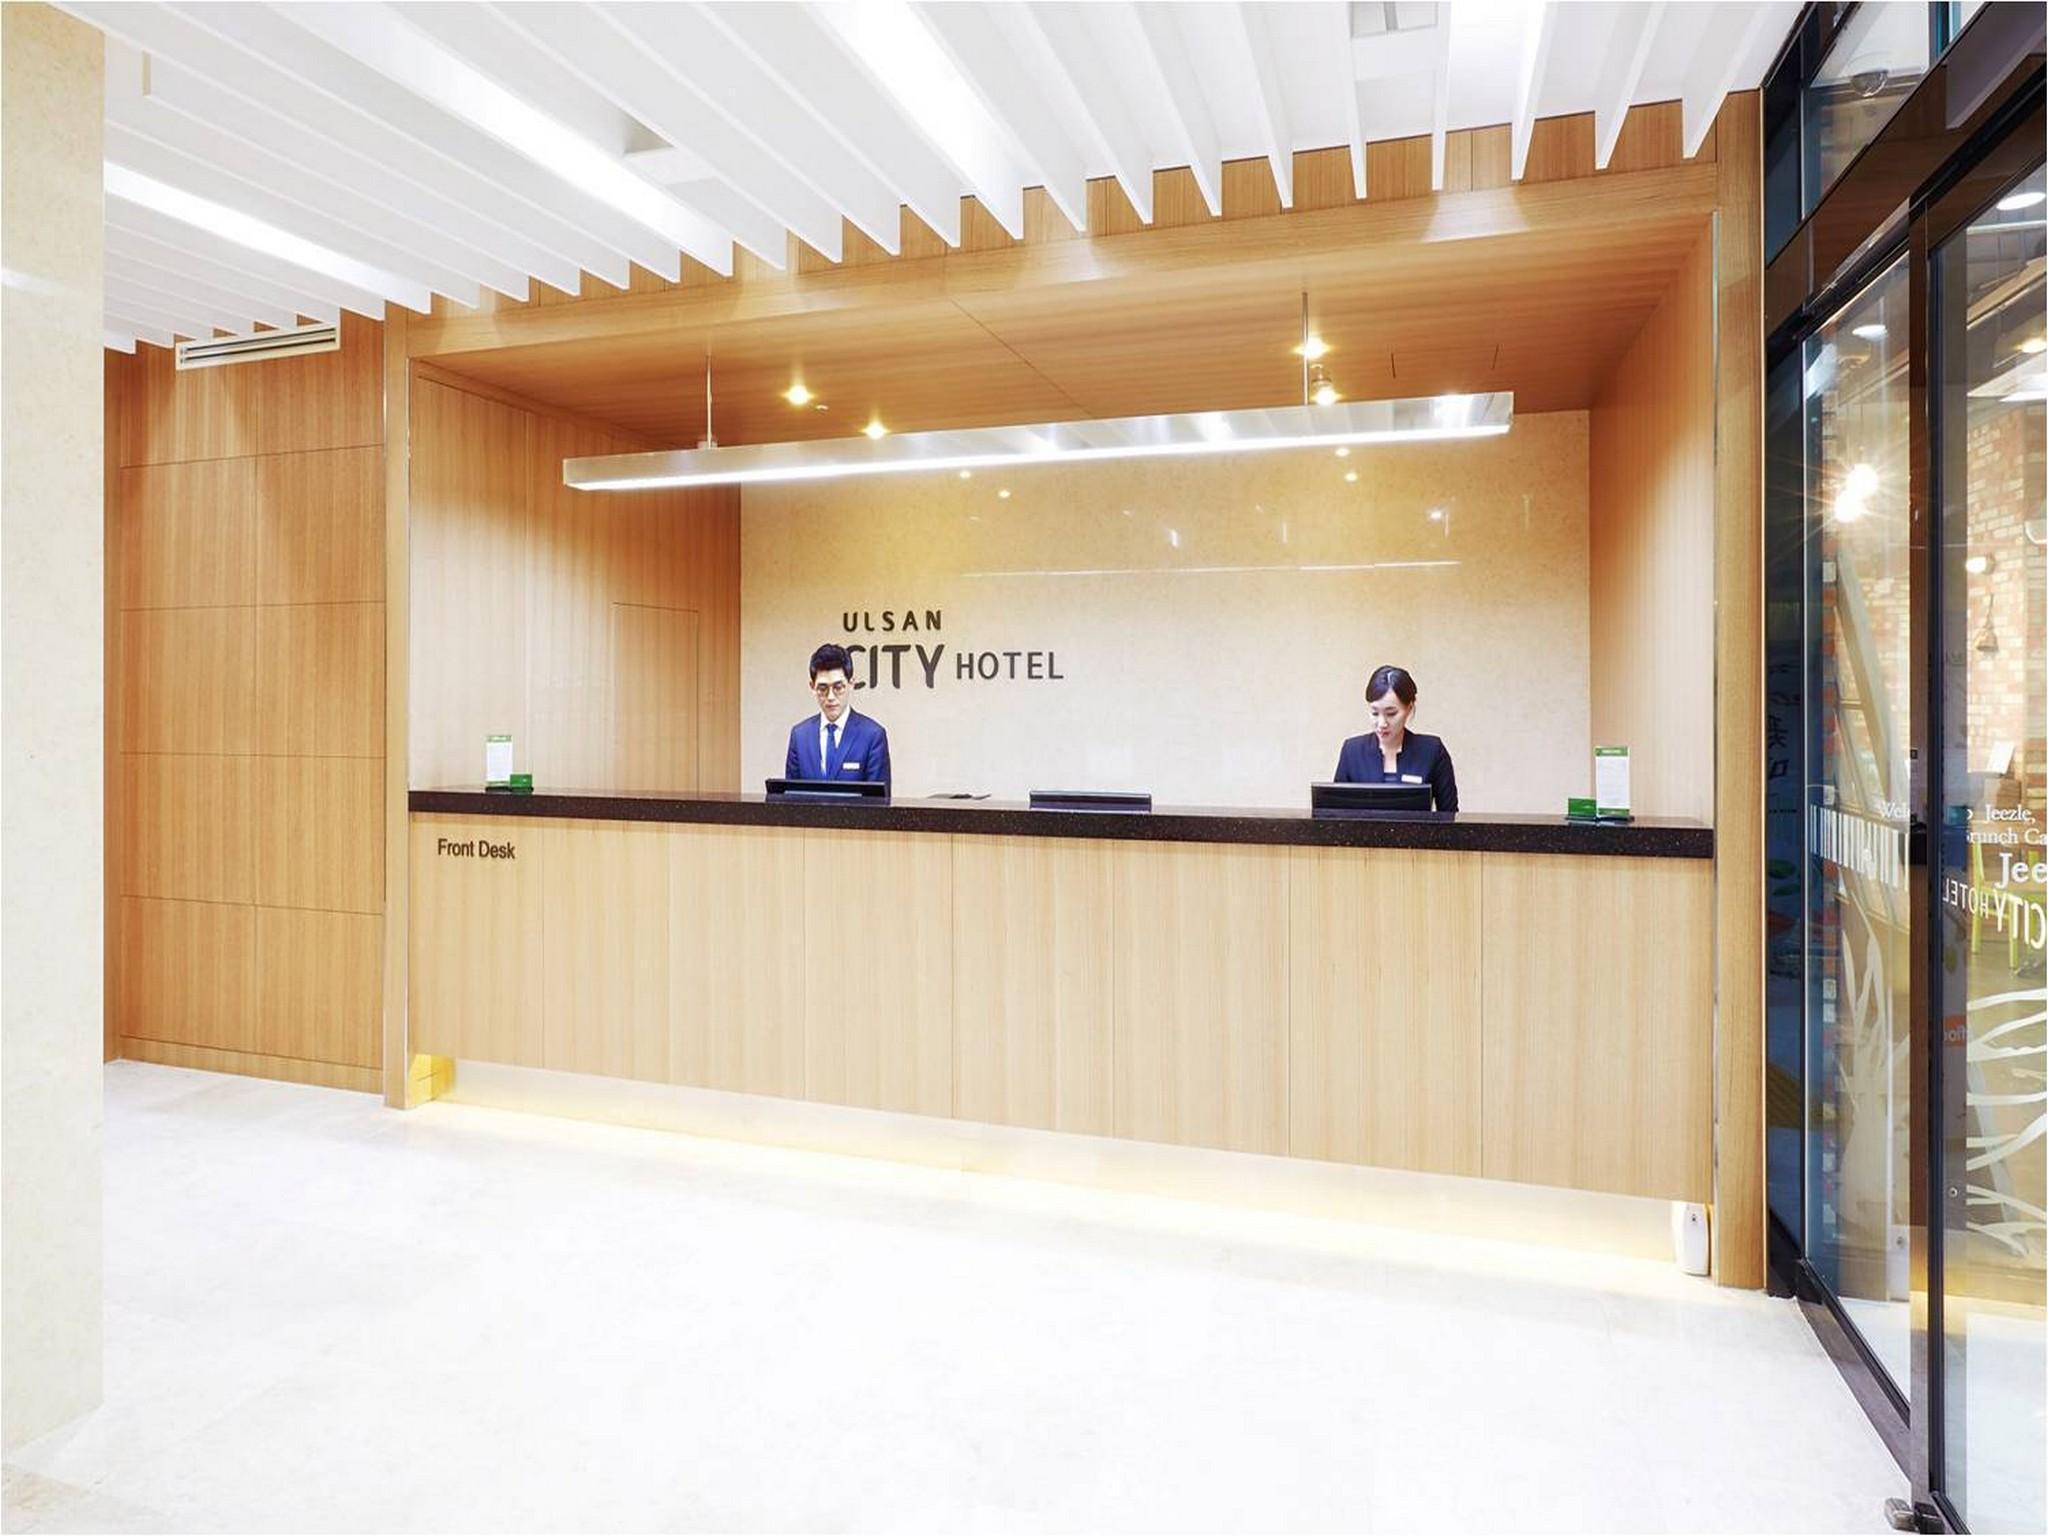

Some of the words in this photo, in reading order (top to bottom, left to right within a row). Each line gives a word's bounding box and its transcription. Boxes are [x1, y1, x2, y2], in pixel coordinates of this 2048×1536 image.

[843, 610, 942, 632] ULSAN
[956, 651, 1064, 680] HOTEL
[1984, 804, 2036, 825] Jeezle,
[1967, 827, 2018, 845] runch
[438, 838, 474, 858] Front
[479, 840, 515, 859] Desk
